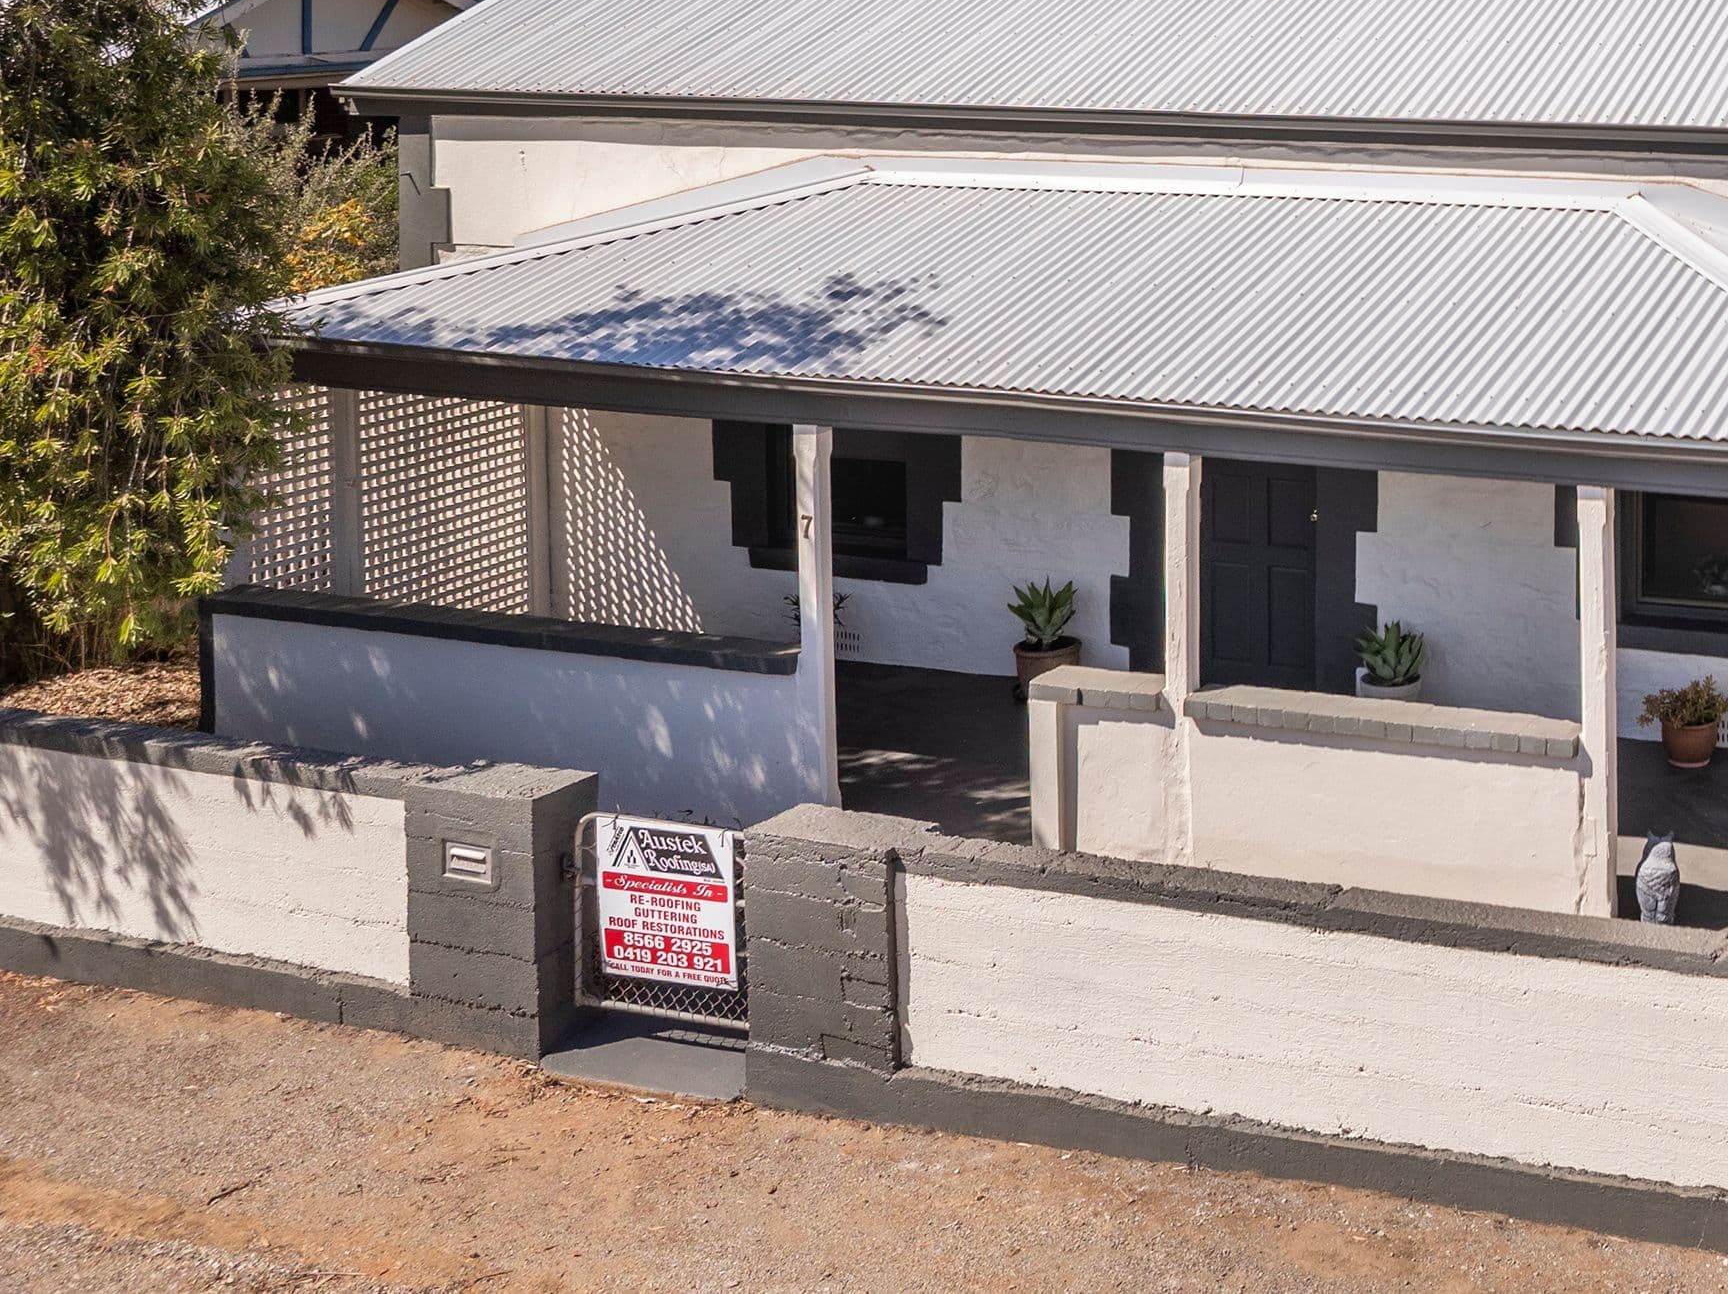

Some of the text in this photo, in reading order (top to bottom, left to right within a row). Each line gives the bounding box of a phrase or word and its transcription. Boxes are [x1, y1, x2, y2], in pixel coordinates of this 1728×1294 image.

[801, 515, 813, 539] 7
[638, 829, 707, 854] Austek
[614, 875, 688, 895] Specialists
[693, 884, 713, 897] In
[630, 894, 701, 912] RE-ROOFING
[634, 907, 698, 924] GUTTERING
[609, 916, 725, 940] ROOF RESTORATIONS
[623, 932, 712, 956] 8566 2925
[613, 945, 723, 972] 0419 203 921
[631, 965, 654, 974] TODAY
[657, 969, 673, 978] FOR
[683, 973, 702, 981] FREE
